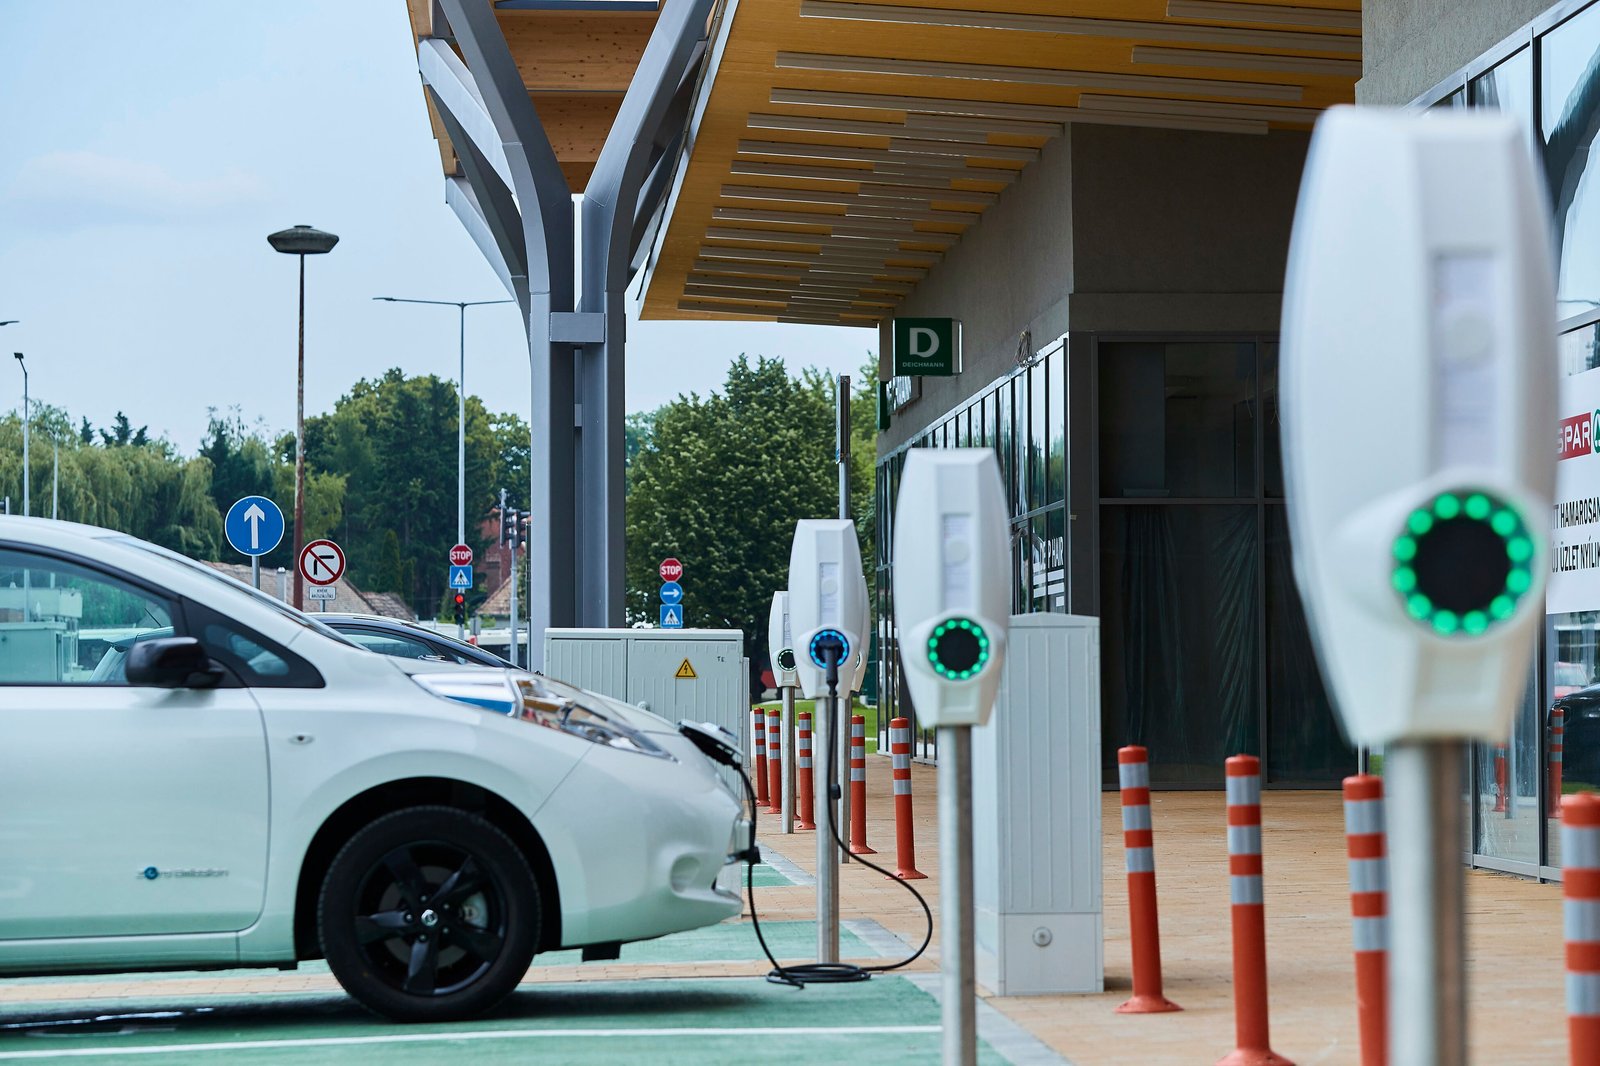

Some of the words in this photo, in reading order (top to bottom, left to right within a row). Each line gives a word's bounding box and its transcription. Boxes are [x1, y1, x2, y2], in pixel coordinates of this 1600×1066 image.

[909, 327, 940, 358] D
[451, 551, 471, 560] STOP
[661, 565, 681, 575] STOP
